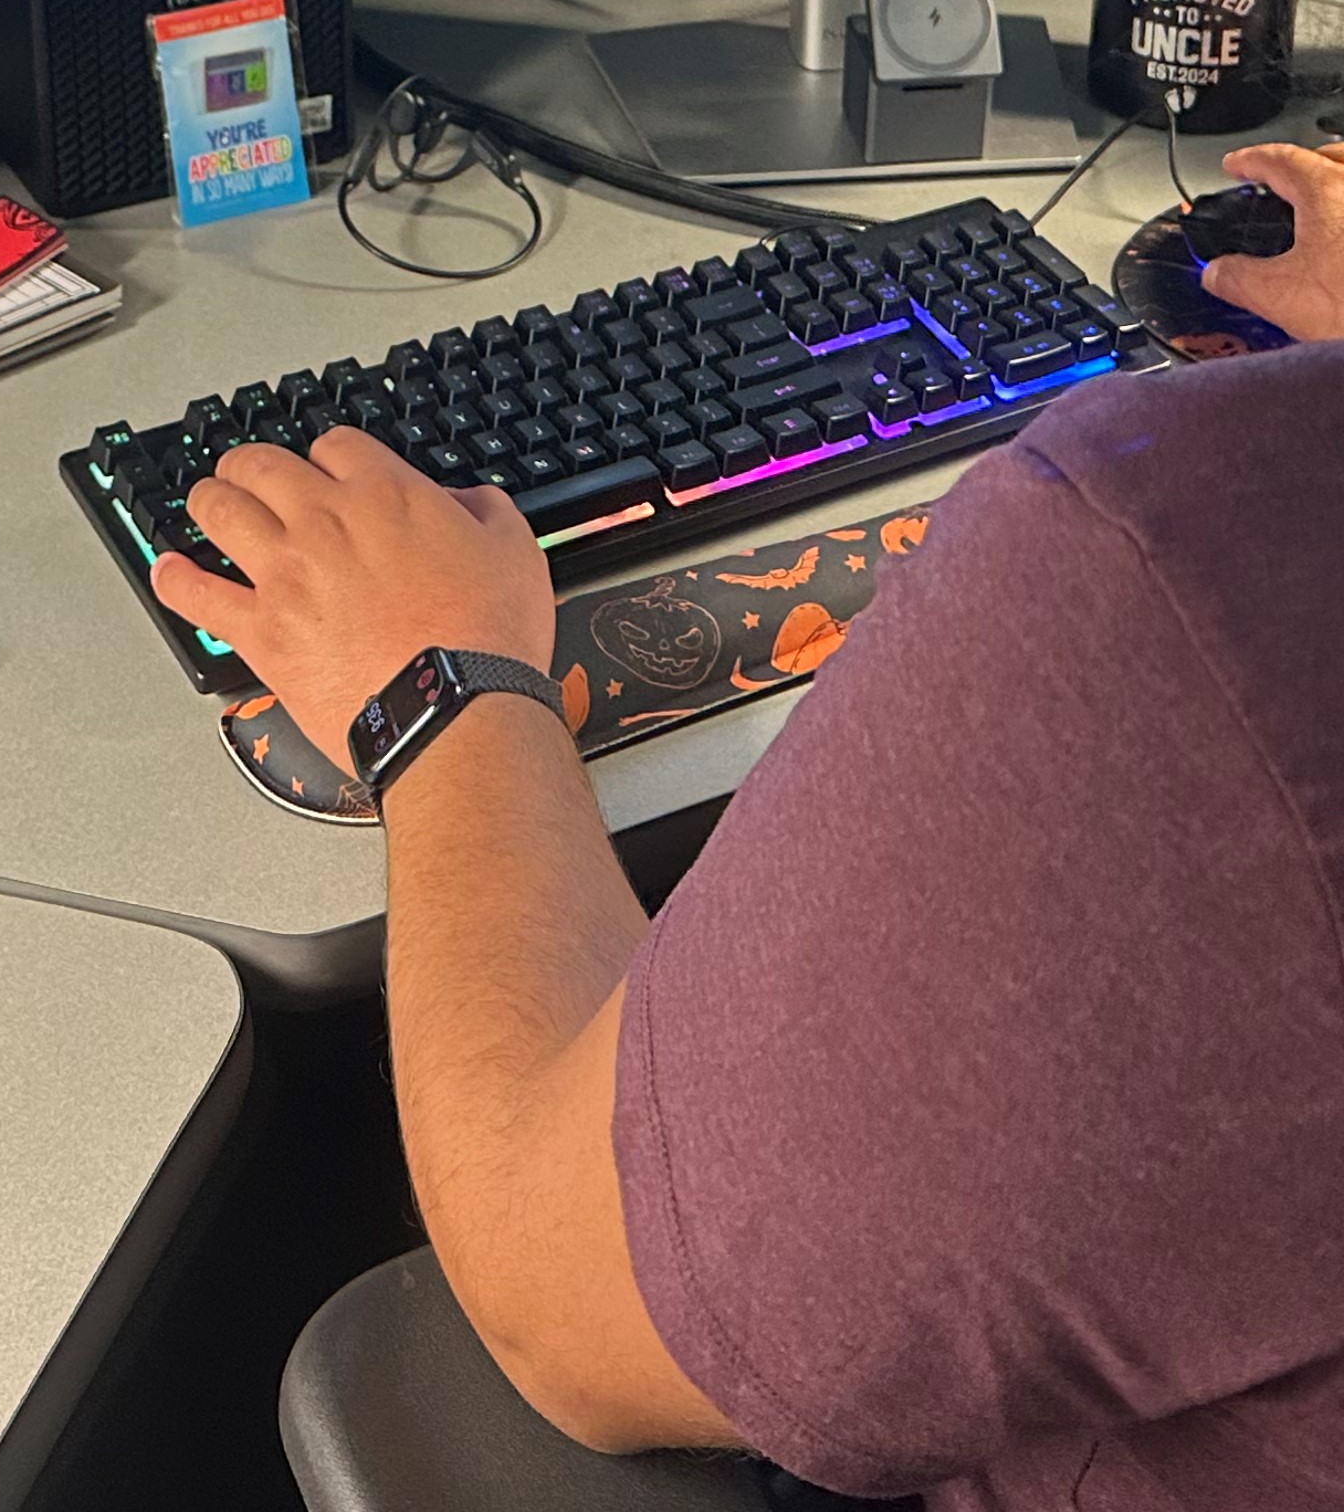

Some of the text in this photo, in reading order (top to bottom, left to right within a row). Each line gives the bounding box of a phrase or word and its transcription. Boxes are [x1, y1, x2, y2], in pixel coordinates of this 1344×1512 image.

[1175, 6, 1199, 24] TO
[1132, 17, 1242, 66] UNCLE
[207, 119, 267, 149] YOU'RE
[190, 136, 293, 182] APPRECIATED
[191, 184, 204, 204] IN
[208, 178, 221, 200] SO
[225, 171, 257, 196] MANY
